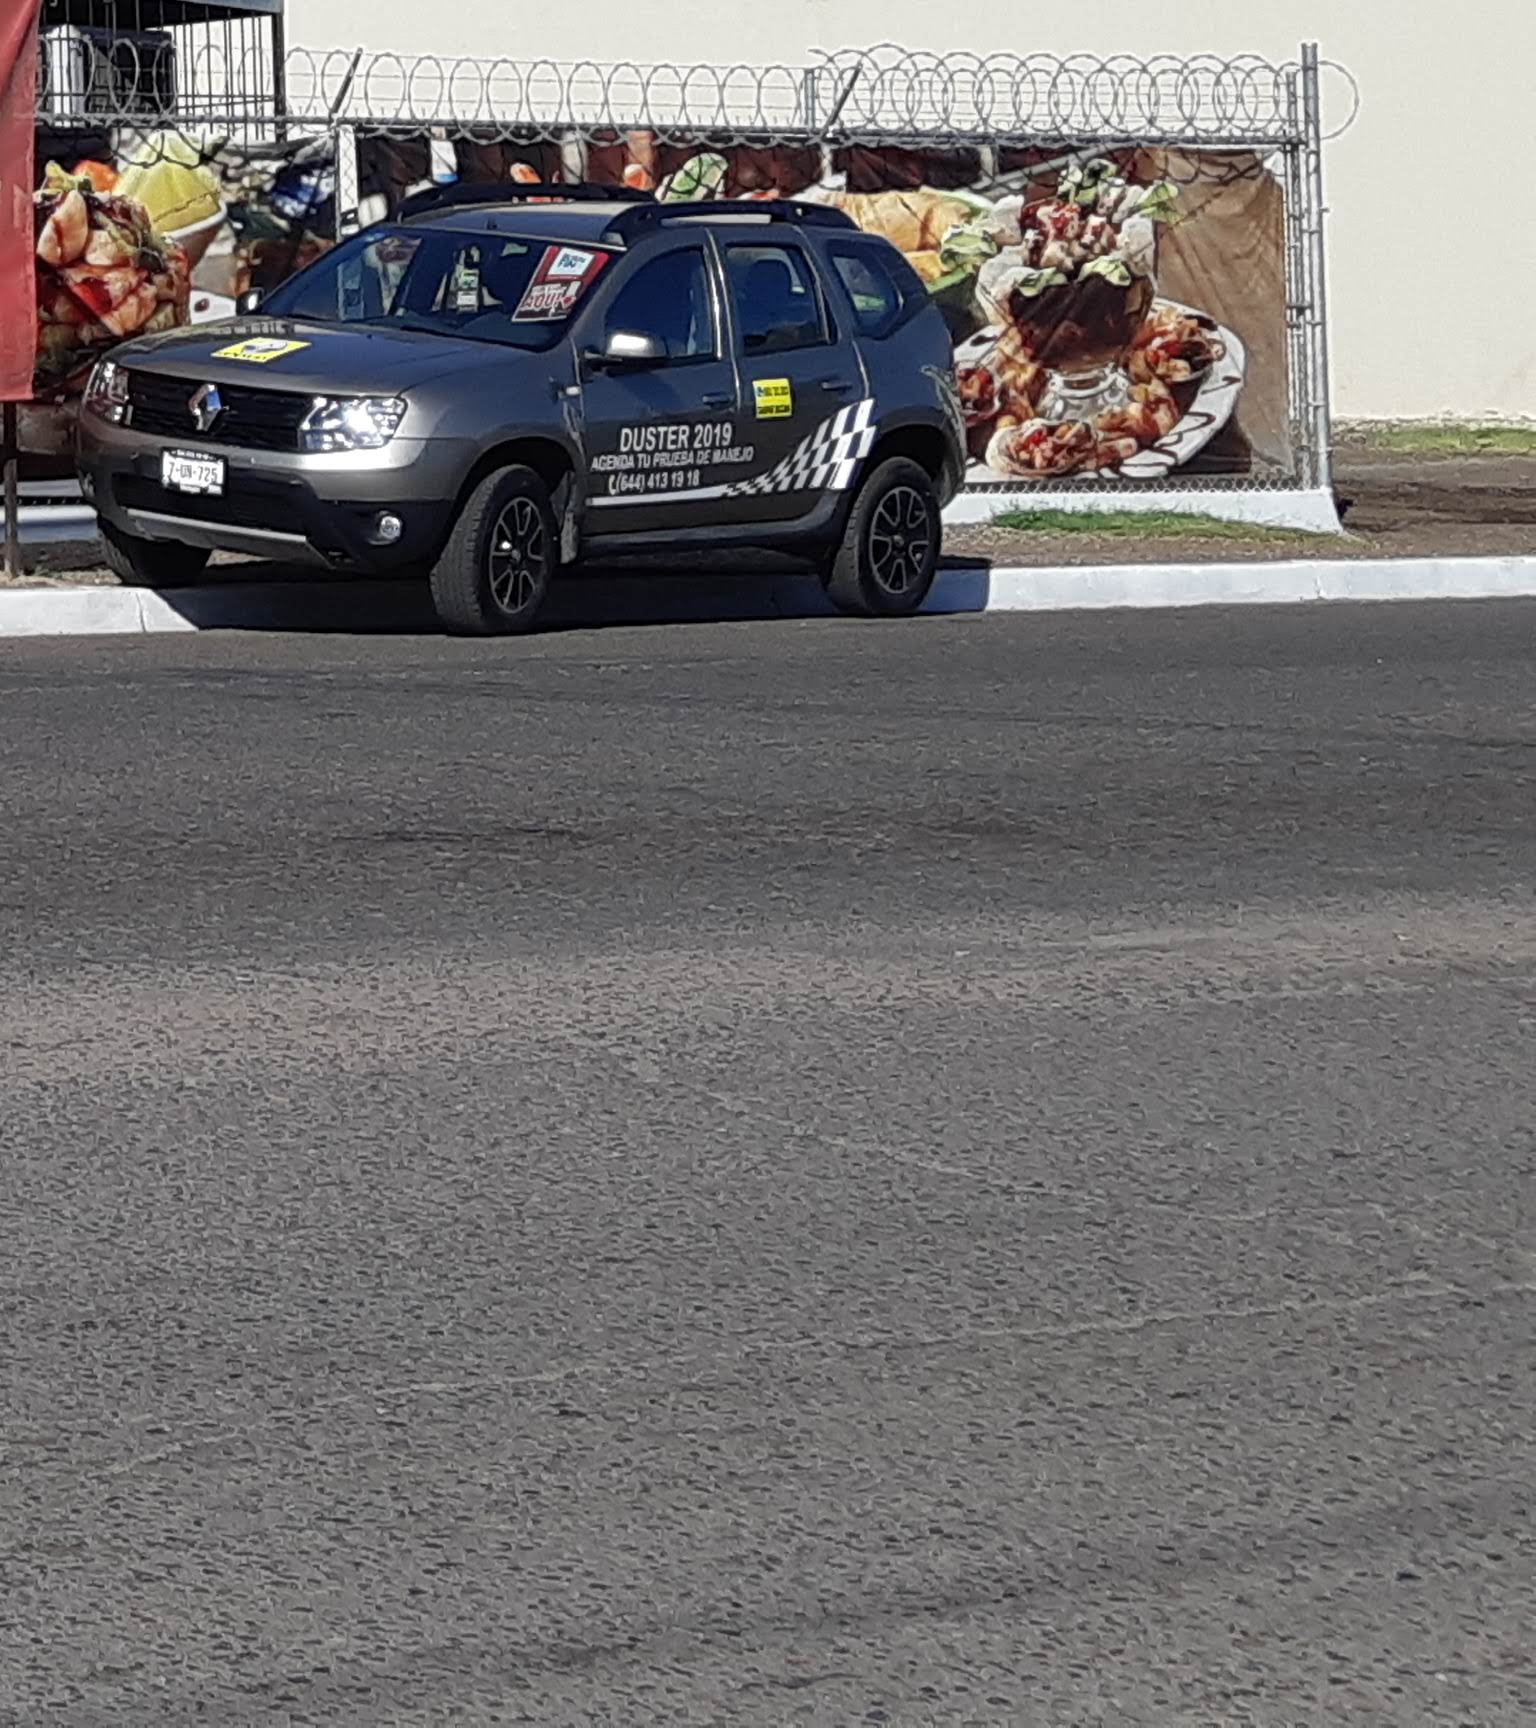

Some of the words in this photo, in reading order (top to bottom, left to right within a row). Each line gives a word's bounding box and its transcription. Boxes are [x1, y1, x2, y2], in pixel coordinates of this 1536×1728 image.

[619, 424, 690, 453] DUSTER
[693, 422, 732, 449] 2019
[590, 454, 635, 472] AGENDA
[637, 452, 651, 469] TU
[652, 450, 694, 468] PRUEBA
[696, 449, 711, 465] DE
[712, 446, 754, 464] MANEJO
[647, 471, 669, 489] 413
